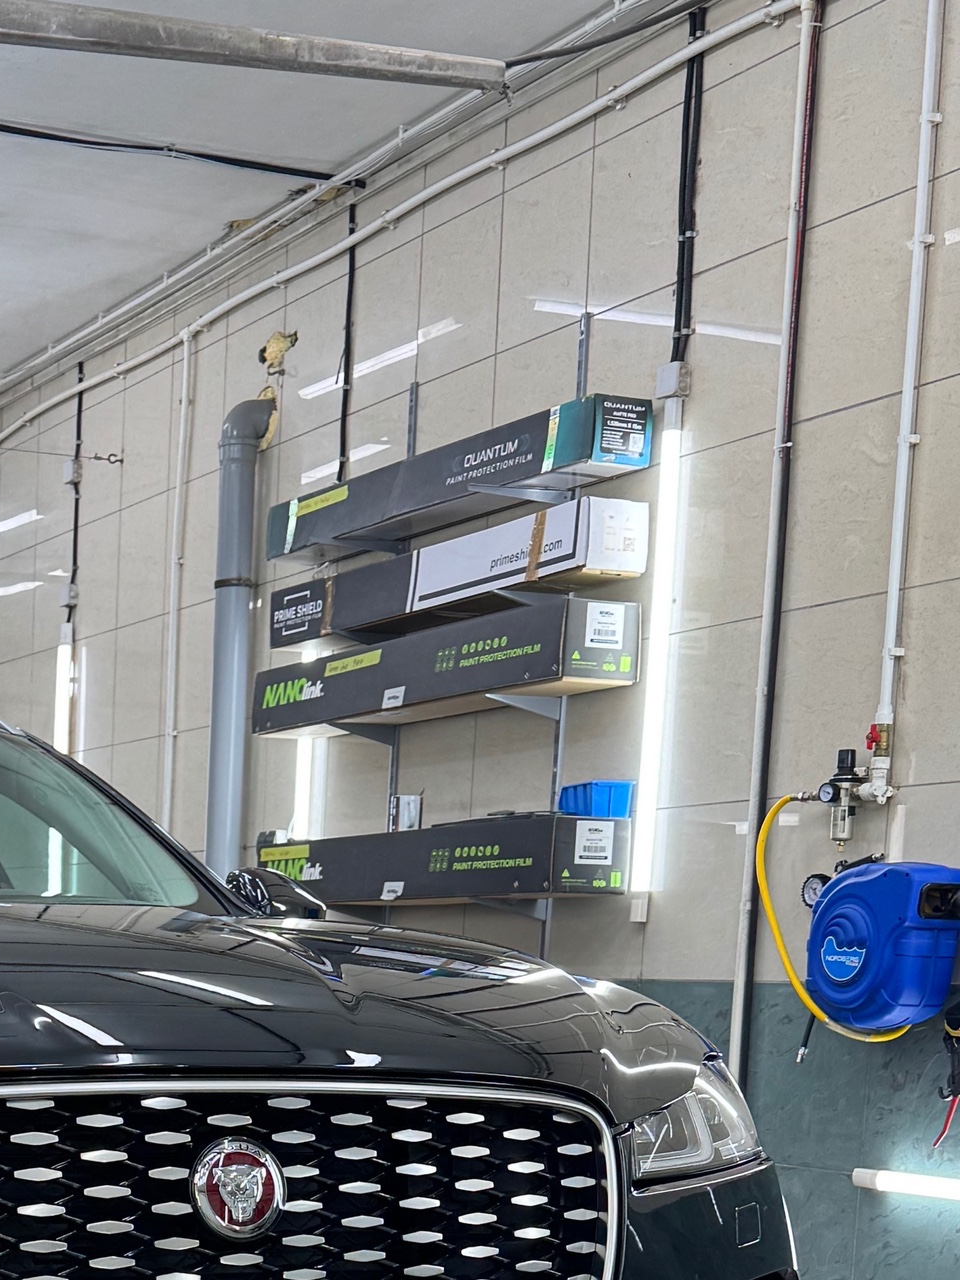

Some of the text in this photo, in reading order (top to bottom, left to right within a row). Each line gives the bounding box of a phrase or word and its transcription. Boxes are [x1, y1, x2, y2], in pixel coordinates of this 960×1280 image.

[603, 401, 646, 411] QUANTUM
[464, 439, 518, 468] QUANTUM
[445, 453, 533, 486] PAINT PROTECTION FILM
[490, 539, 563, 571] primeshi.com
[274, 599, 323, 623] PRIME SHIELD
[459, 643, 541, 668] PAINT PROTECTION FILM
[452, 857, 533, 871] PAINT PROTECTION FILM
